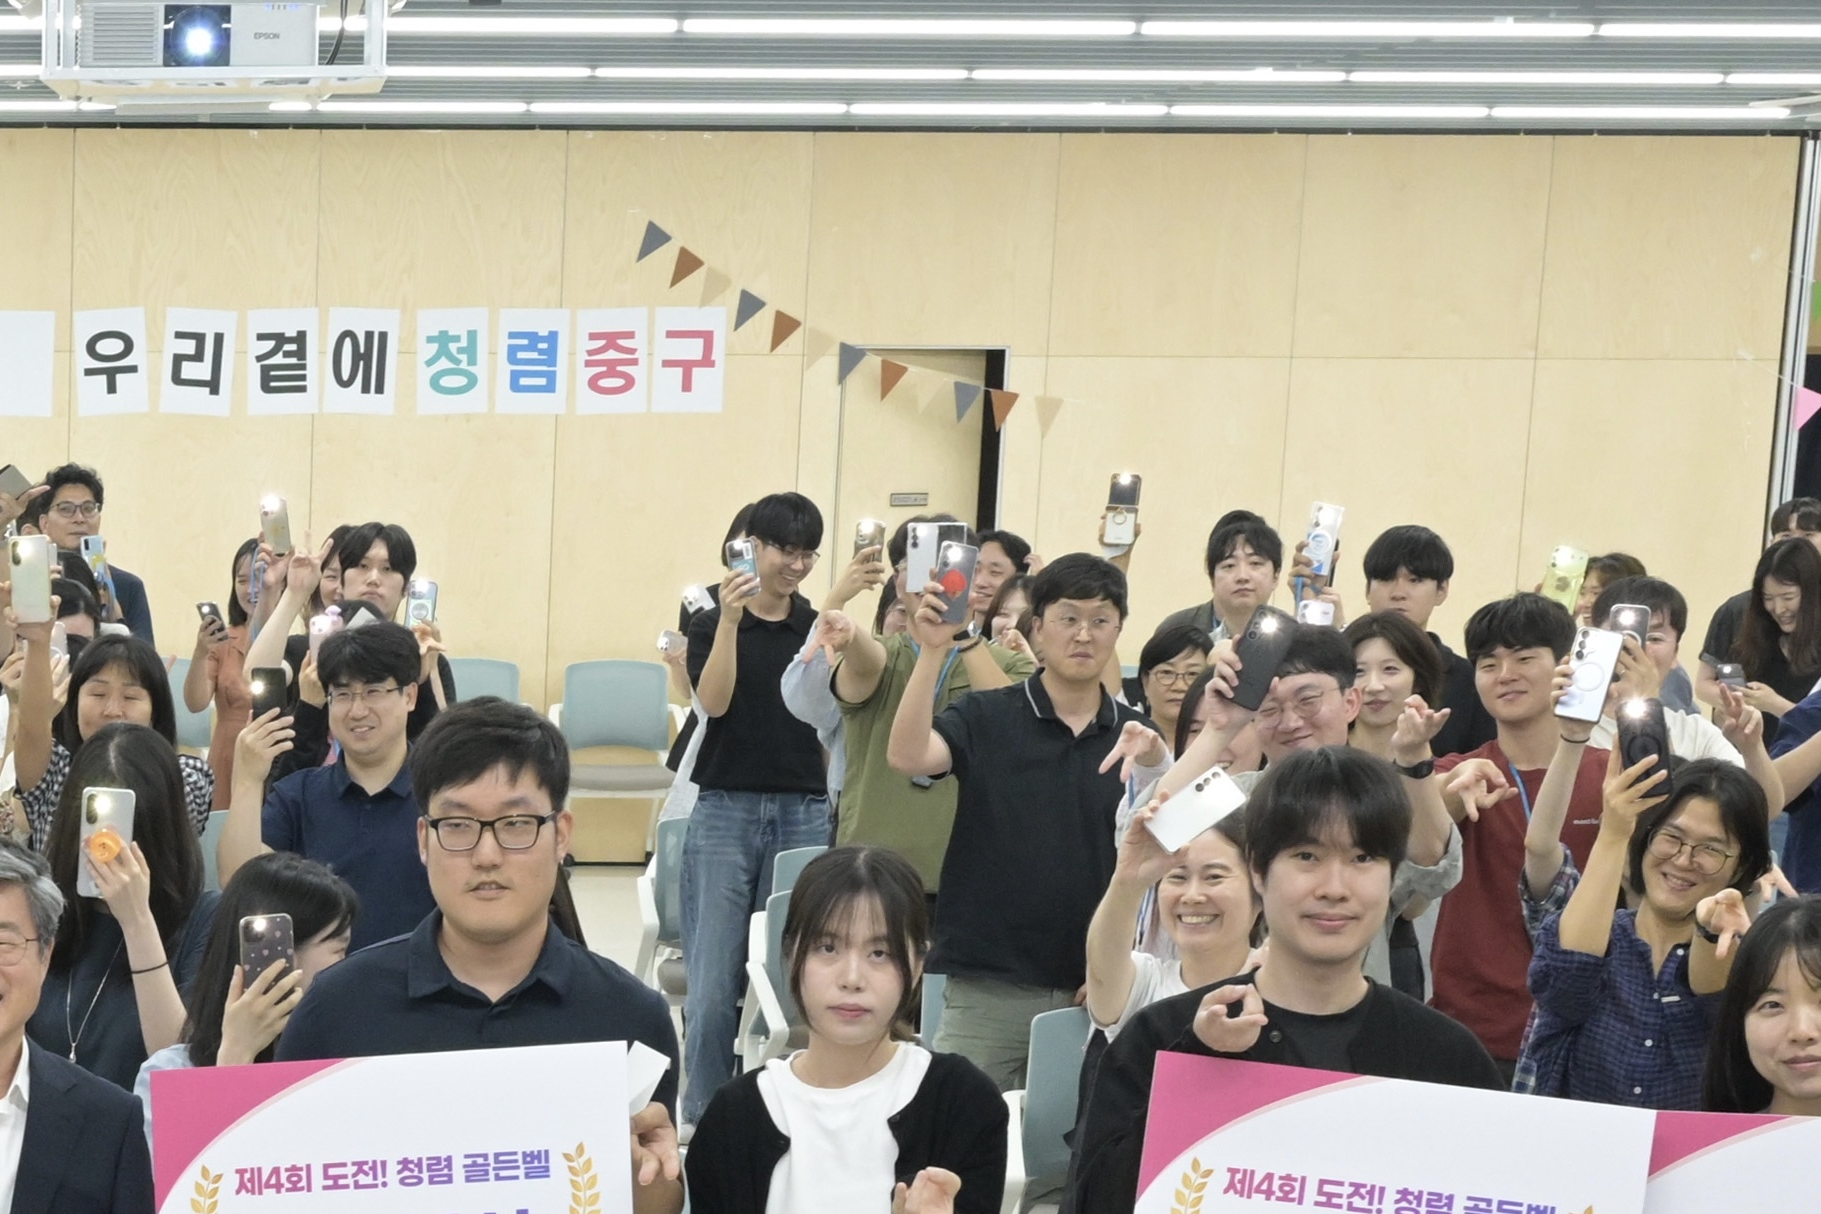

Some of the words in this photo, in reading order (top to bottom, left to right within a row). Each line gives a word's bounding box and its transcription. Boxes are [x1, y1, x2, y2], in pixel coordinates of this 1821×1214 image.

[253, 32, 280, 40] EPSON
[425, 329, 716, 396] 청렴중구
[235, 1164, 312, 1195] 제4회
[322, 1160, 388, 1190] 도전!
[397, 1155, 454, 1187] 청렴
[462, 1149, 551, 1183] 골든벨
[1223, 1167, 1307, 1205] 제4회
[1313, 1179, 1386, 1214] 도전!
